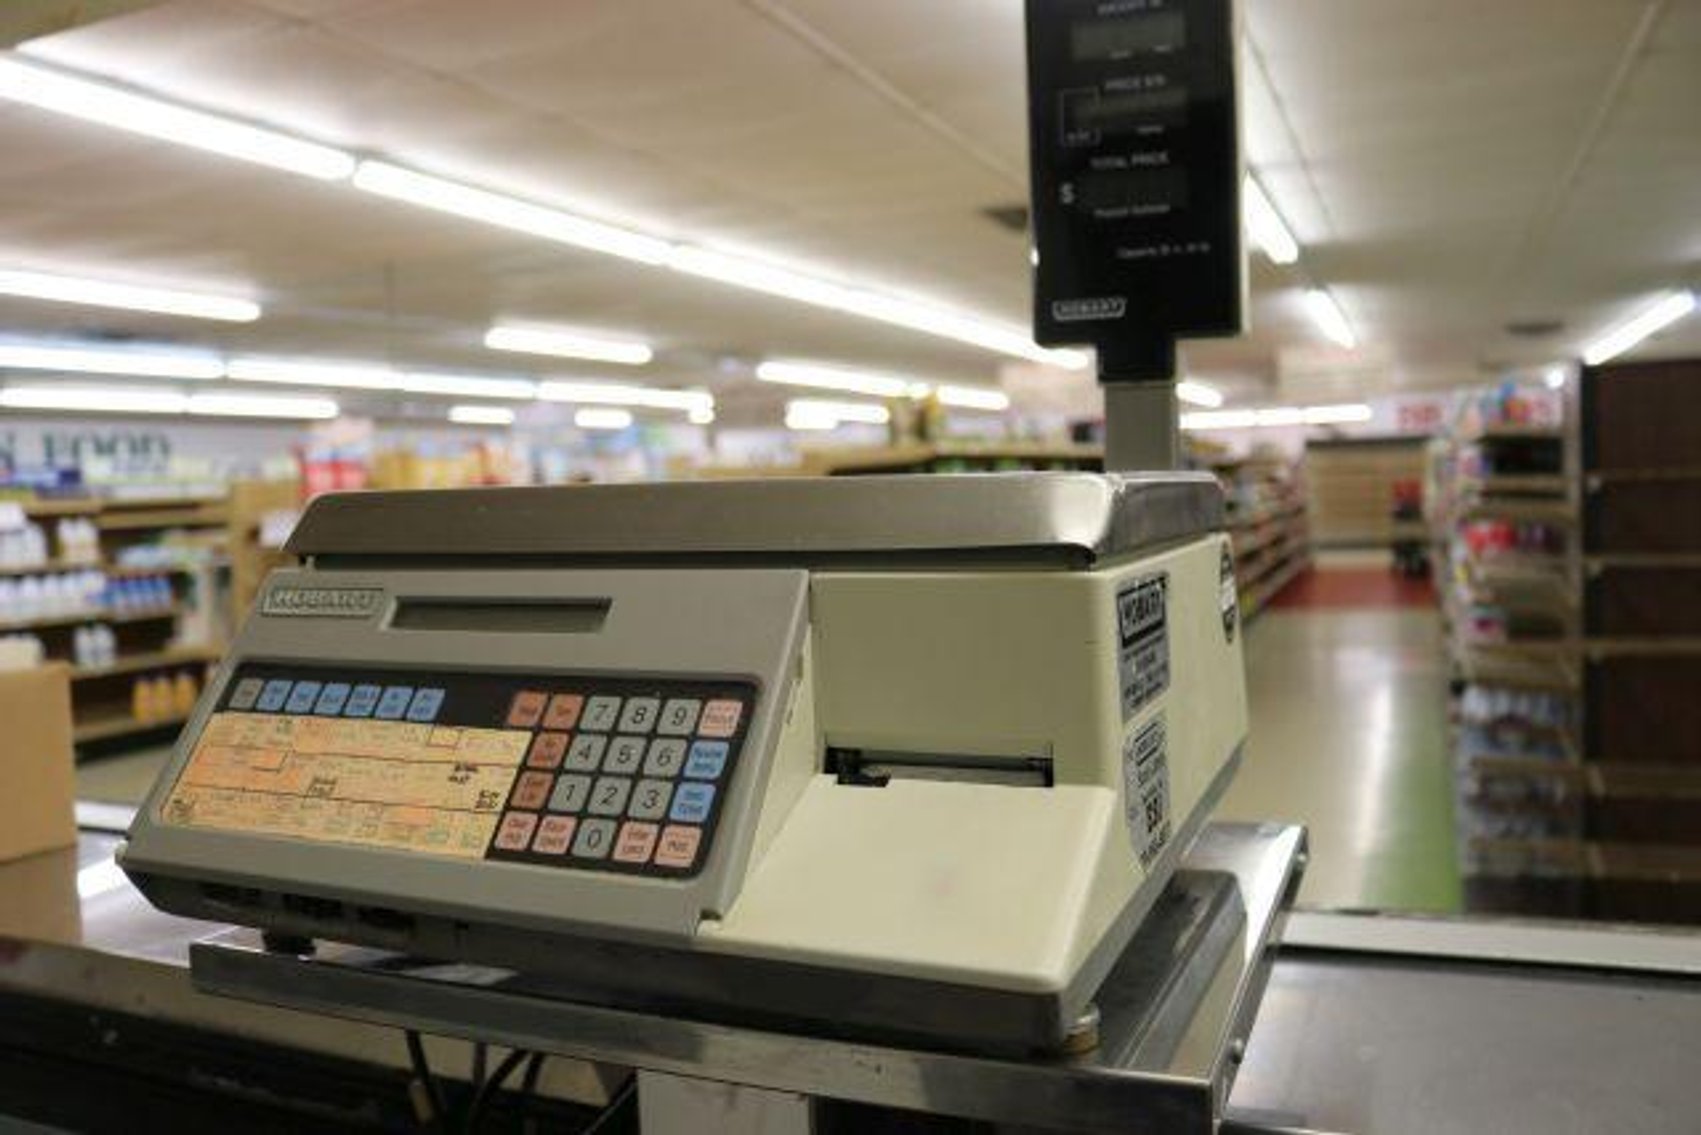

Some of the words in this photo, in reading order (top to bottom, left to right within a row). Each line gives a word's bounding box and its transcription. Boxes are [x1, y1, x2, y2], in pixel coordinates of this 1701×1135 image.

[596, 703, 614, 723] 7
[632, 706, 648, 726] 8
[671, 706, 688, 727] 9
[577, 743, 593, 761] 4
[616, 744, 633, 764] 5
[656, 747, 673, 767] 6
[564, 783, 577, 802] 1
[599, 786, 619, 807] 2
[642, 789, 659, 809] 3
[587, 828, 602, 850] 0
